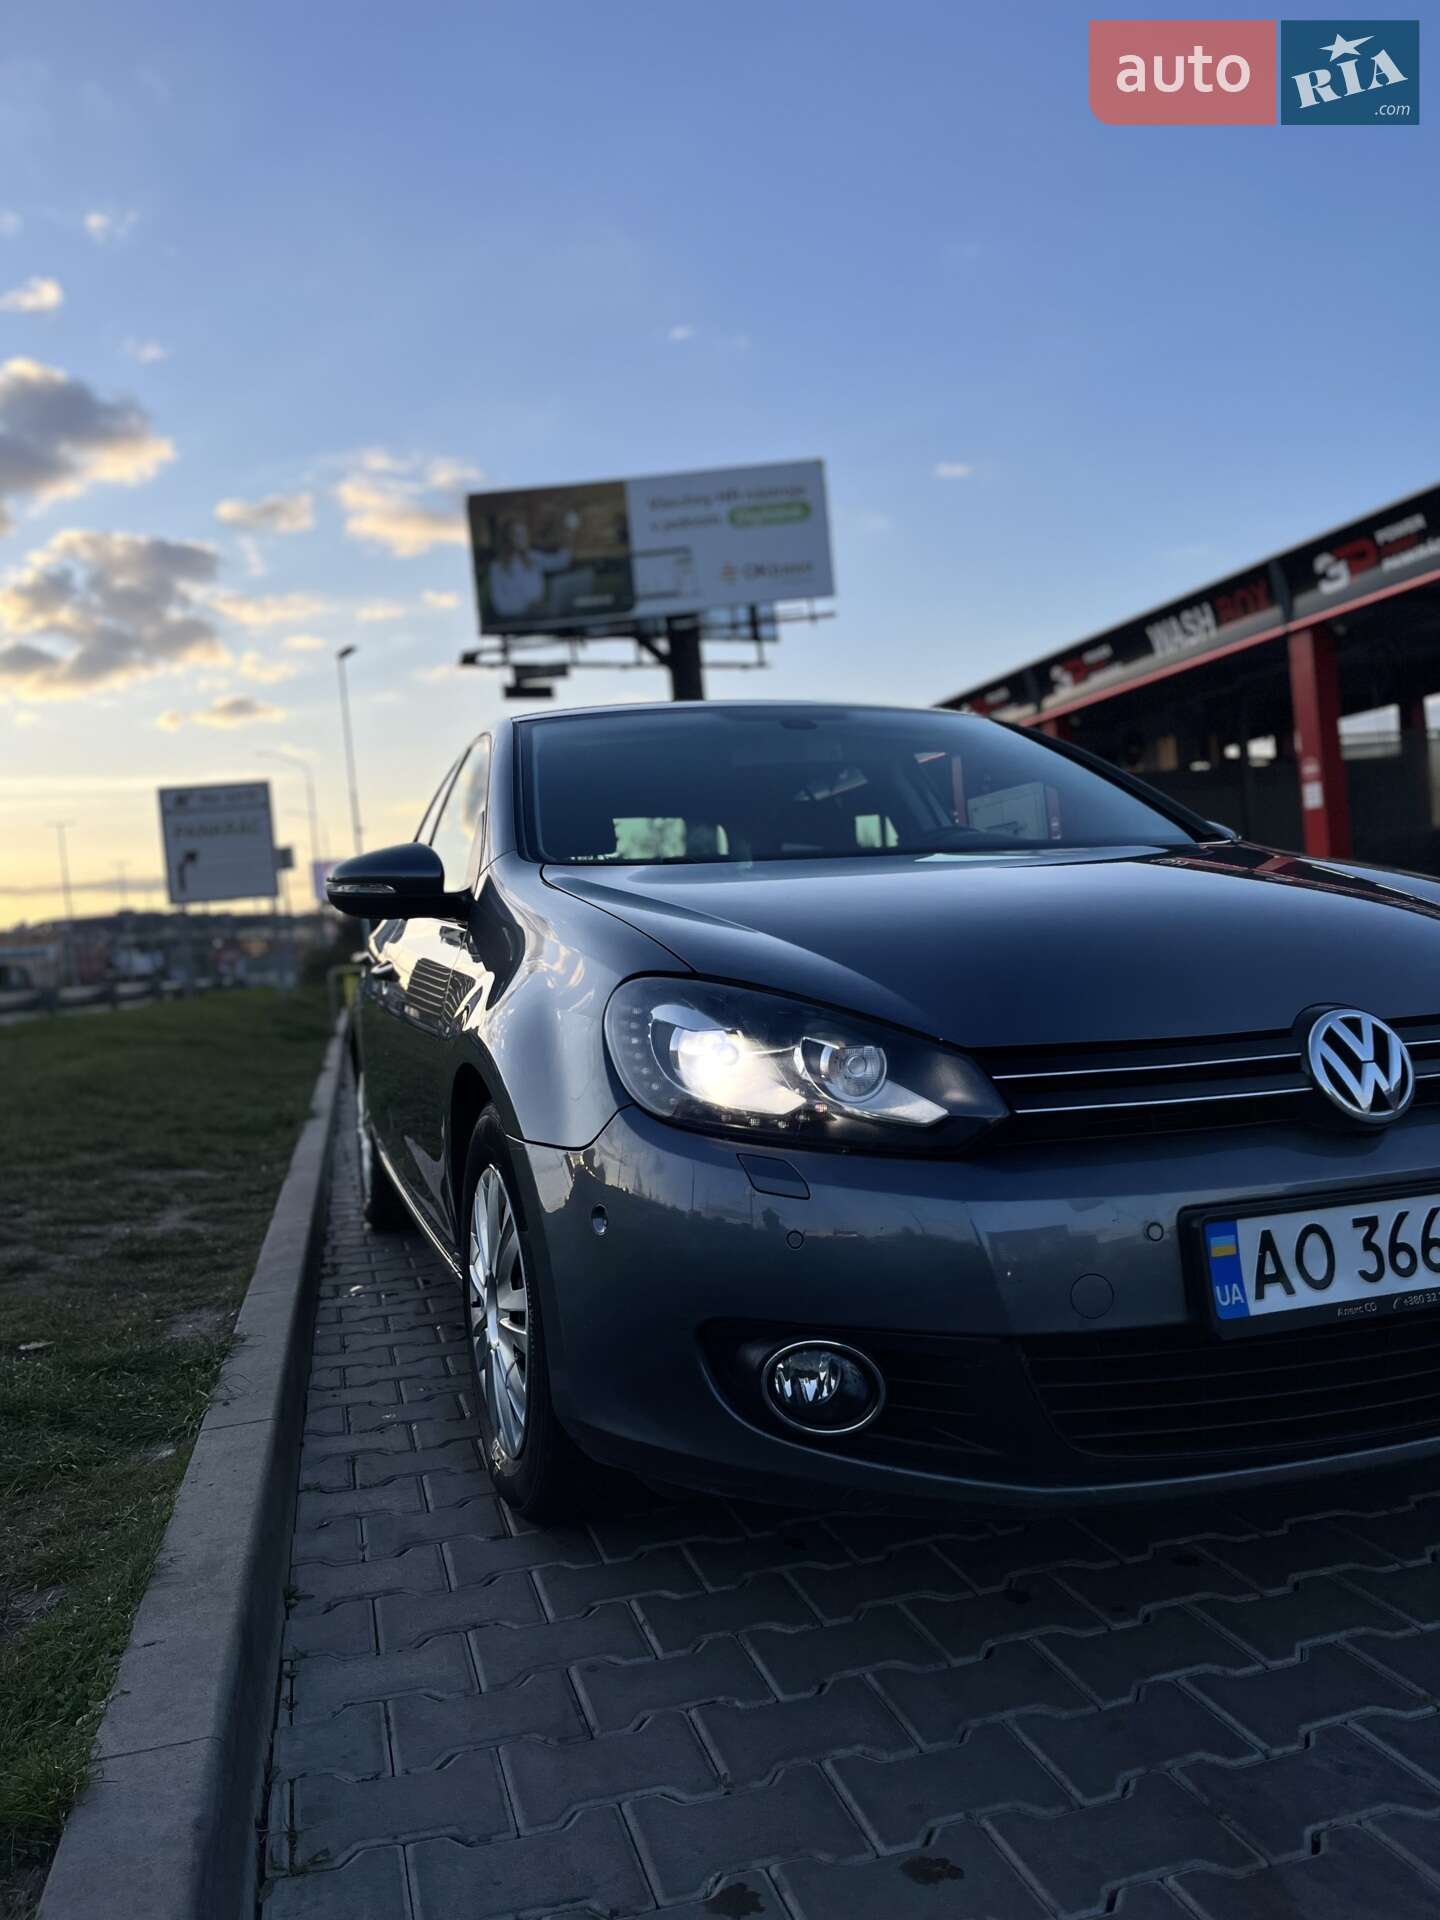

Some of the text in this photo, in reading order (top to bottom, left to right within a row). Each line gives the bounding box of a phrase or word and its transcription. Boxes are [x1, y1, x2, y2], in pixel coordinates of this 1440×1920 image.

[1146, 582, 1269, 658] WASH BOX
[1314, 1011, 1409, 1117] VW
[1216, 1283, 1245, 1306] UA
[1255, 1223, 1336, 1300] AO
